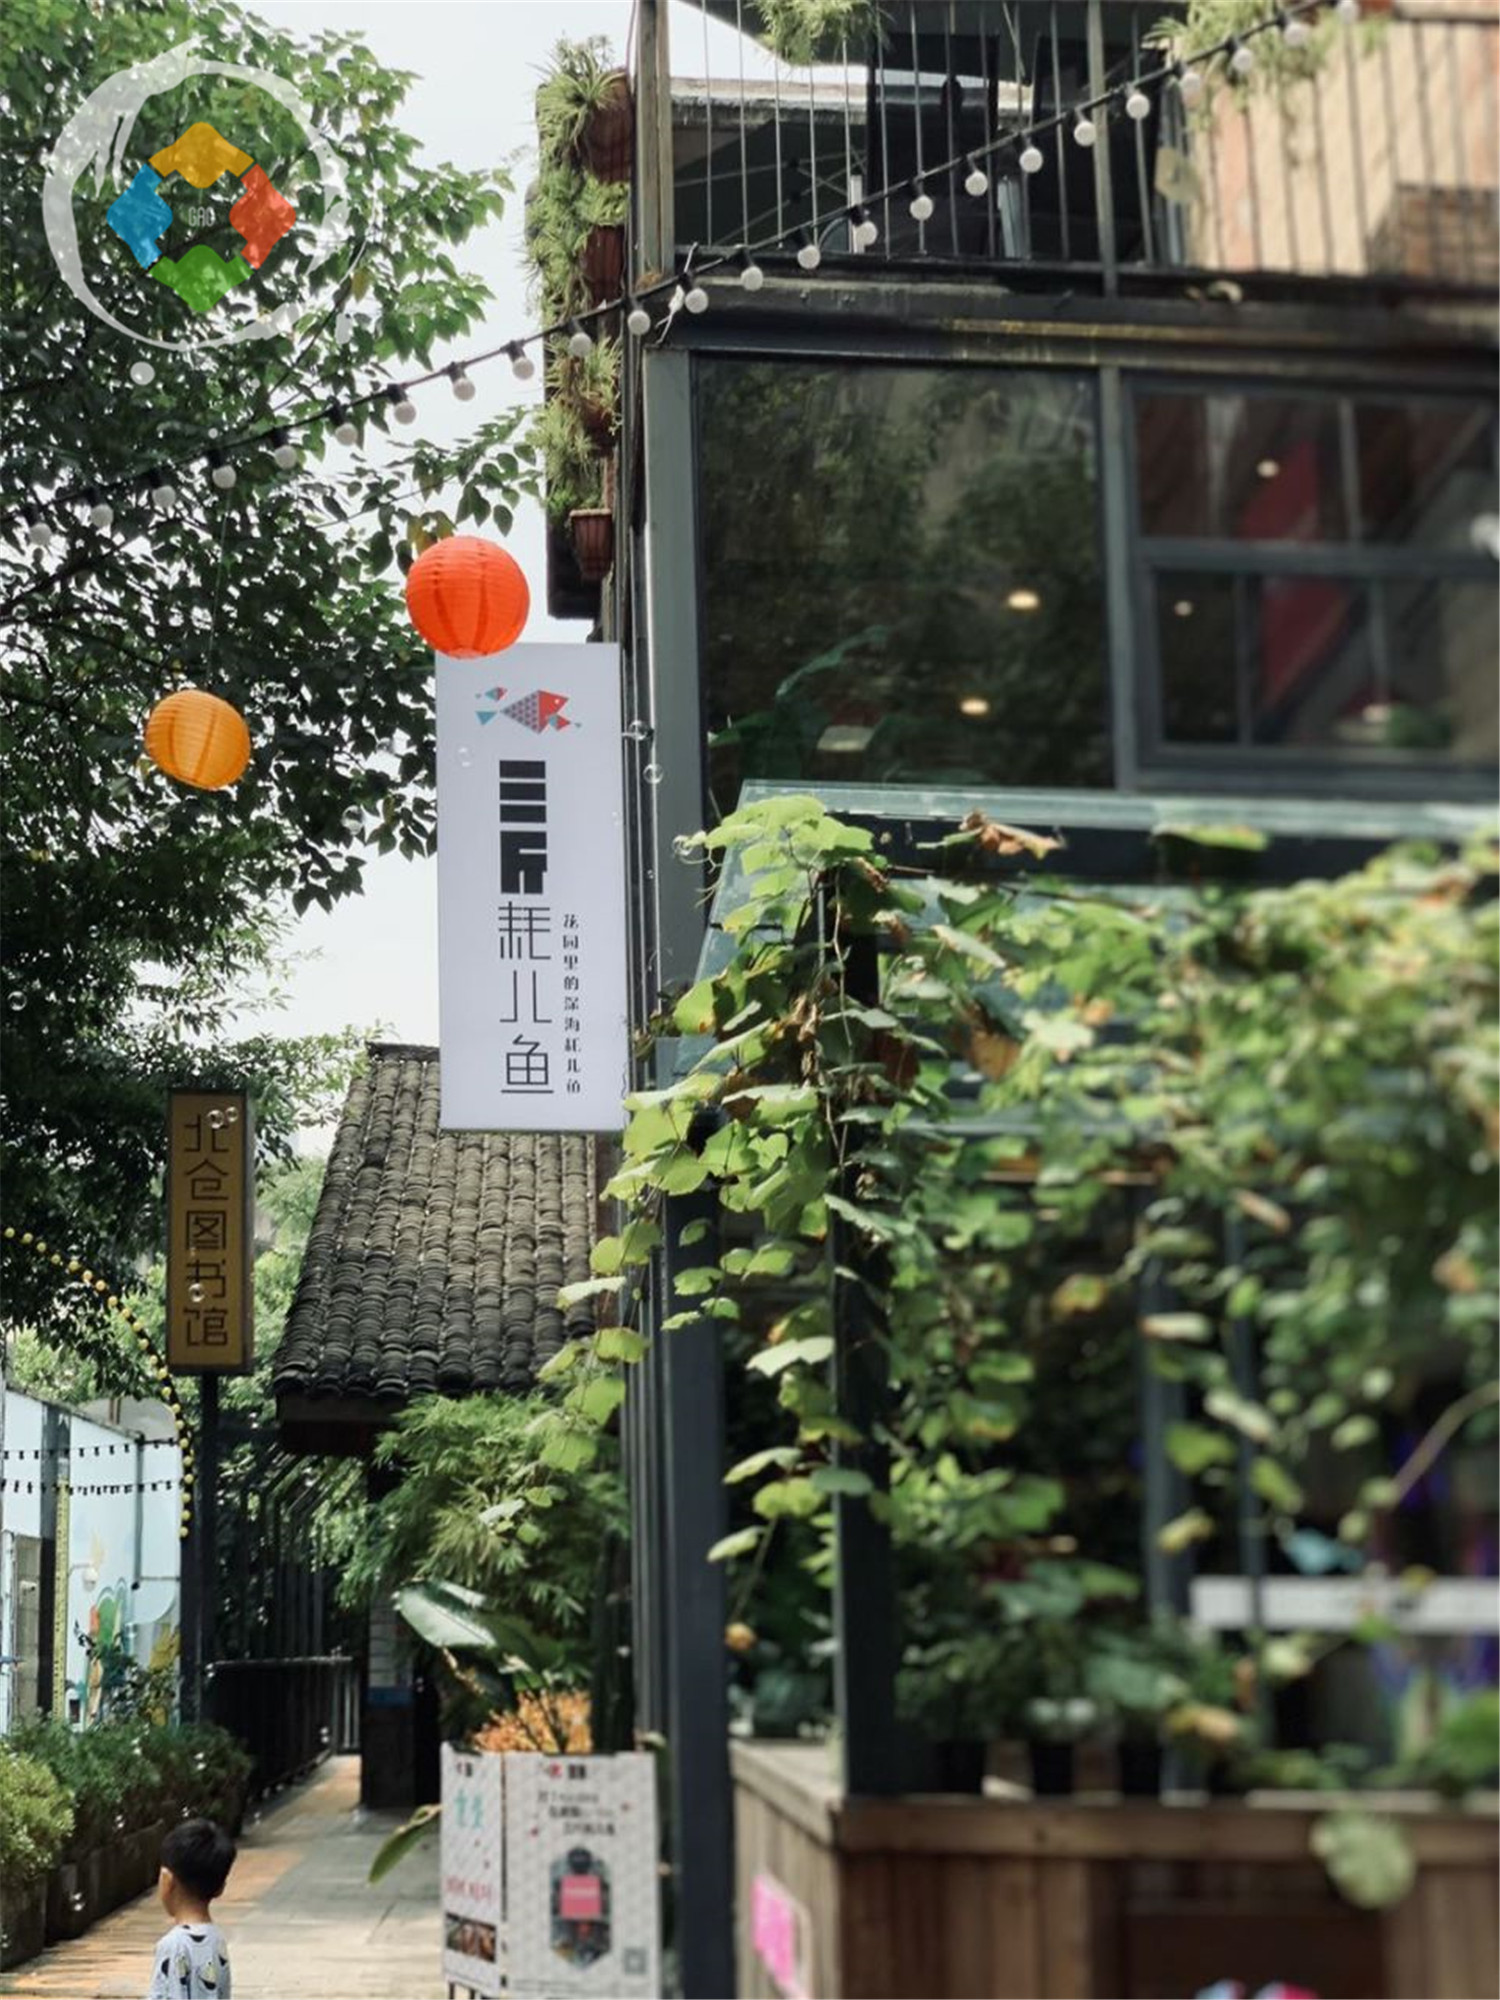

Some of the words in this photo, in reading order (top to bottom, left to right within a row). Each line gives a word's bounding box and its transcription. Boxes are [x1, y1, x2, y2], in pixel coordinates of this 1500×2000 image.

[183, 1114, 229, 1347] 北仓图书馆
